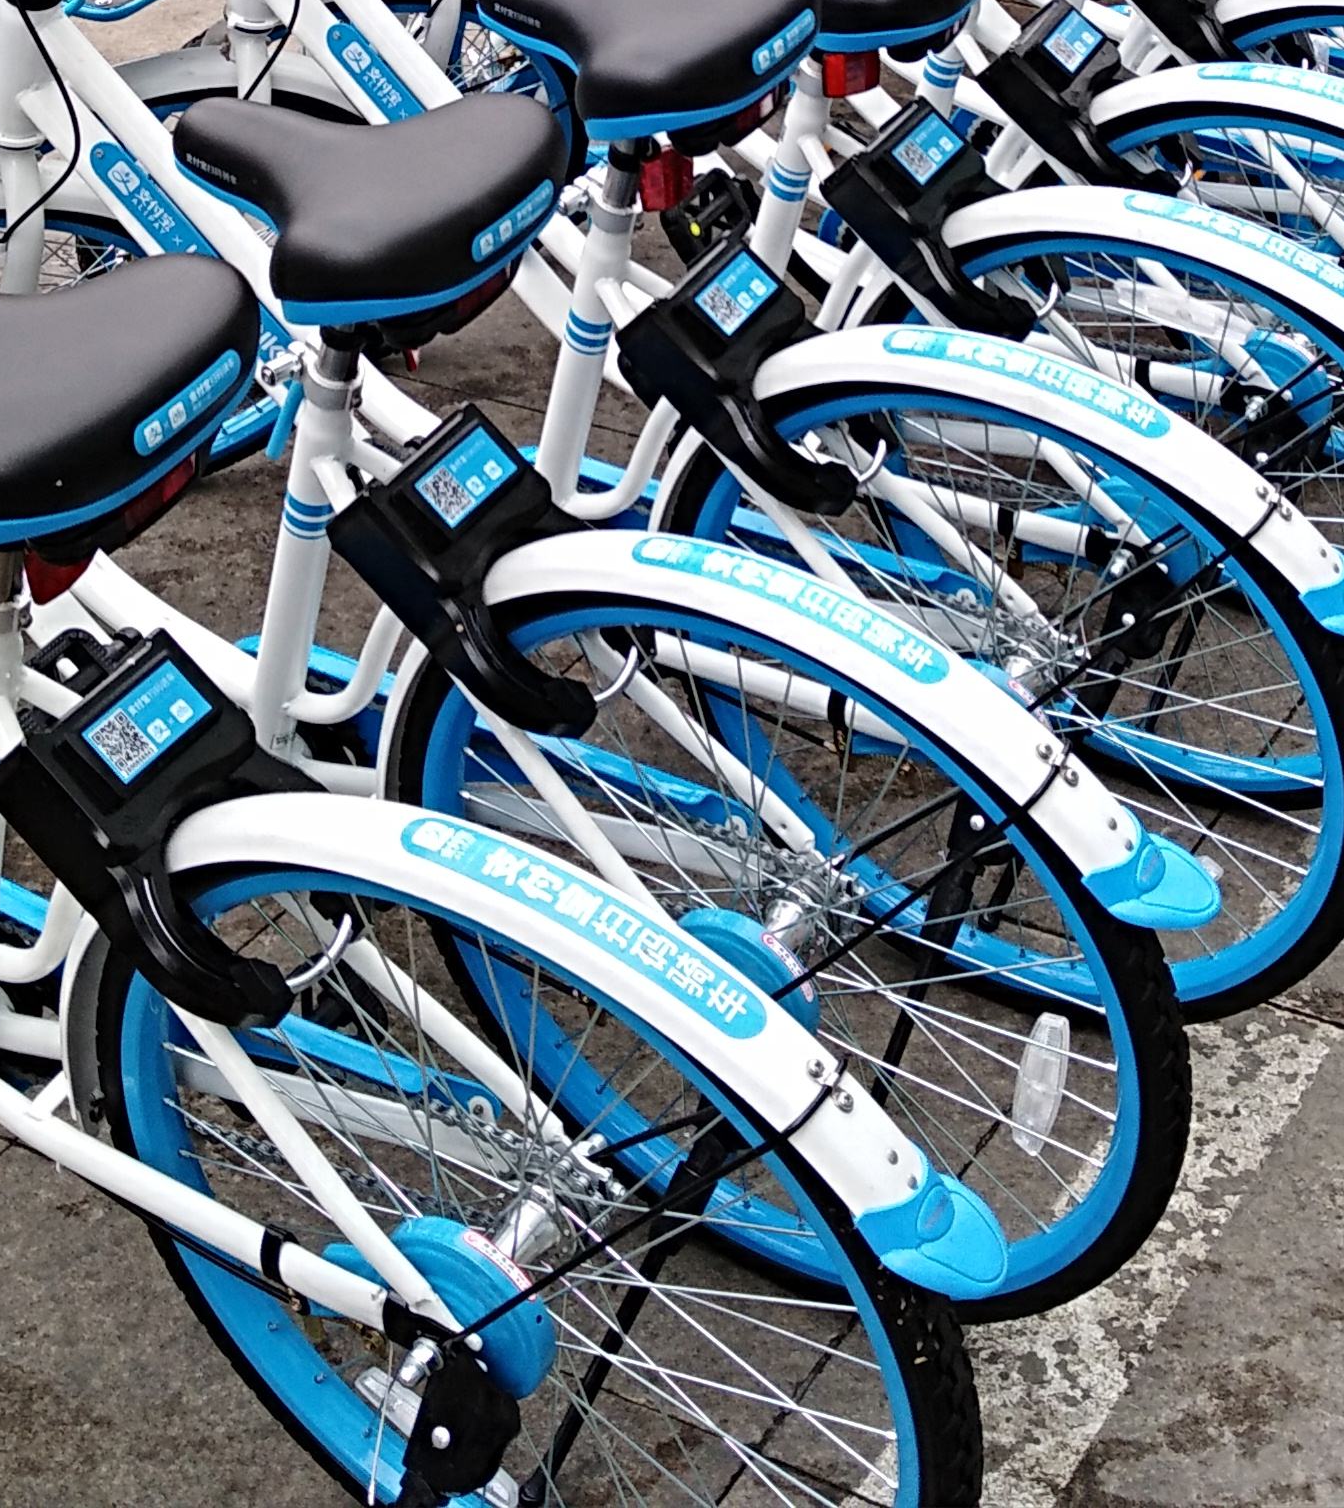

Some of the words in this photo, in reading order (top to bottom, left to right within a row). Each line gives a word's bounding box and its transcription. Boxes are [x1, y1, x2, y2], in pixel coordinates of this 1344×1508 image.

[365, 66, 402, 108] 支付宝
[134, 188, 176, 232] 支付宝
